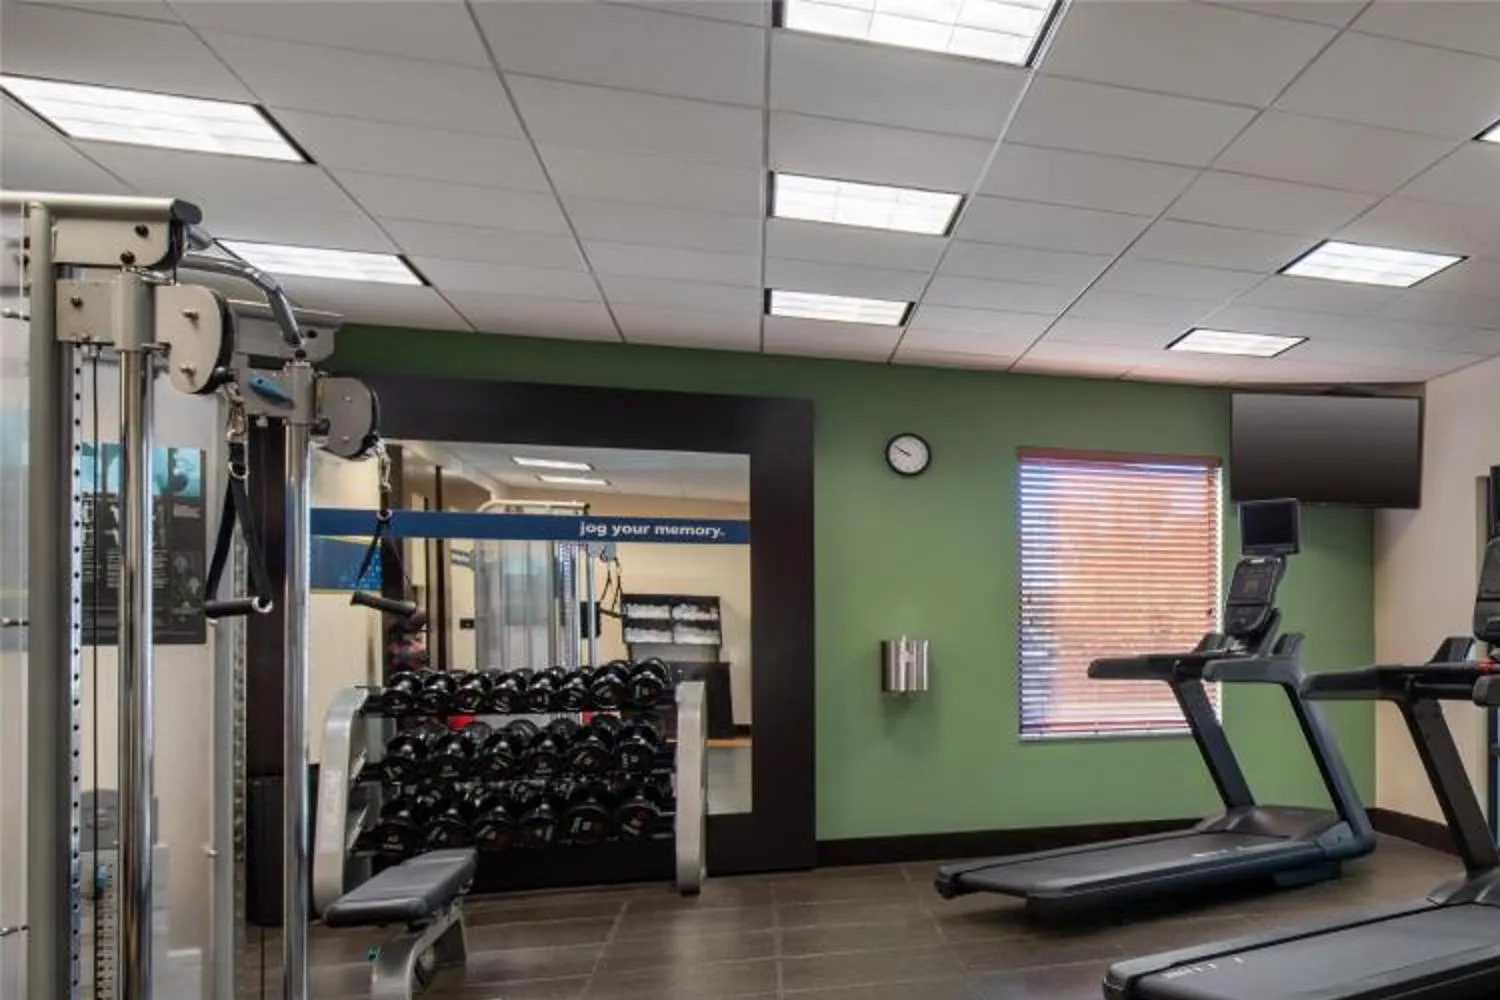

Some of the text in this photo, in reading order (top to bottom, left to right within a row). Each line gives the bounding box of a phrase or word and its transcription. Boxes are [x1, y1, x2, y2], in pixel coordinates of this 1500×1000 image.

[580, 521, 725, 539] jog your memory.
